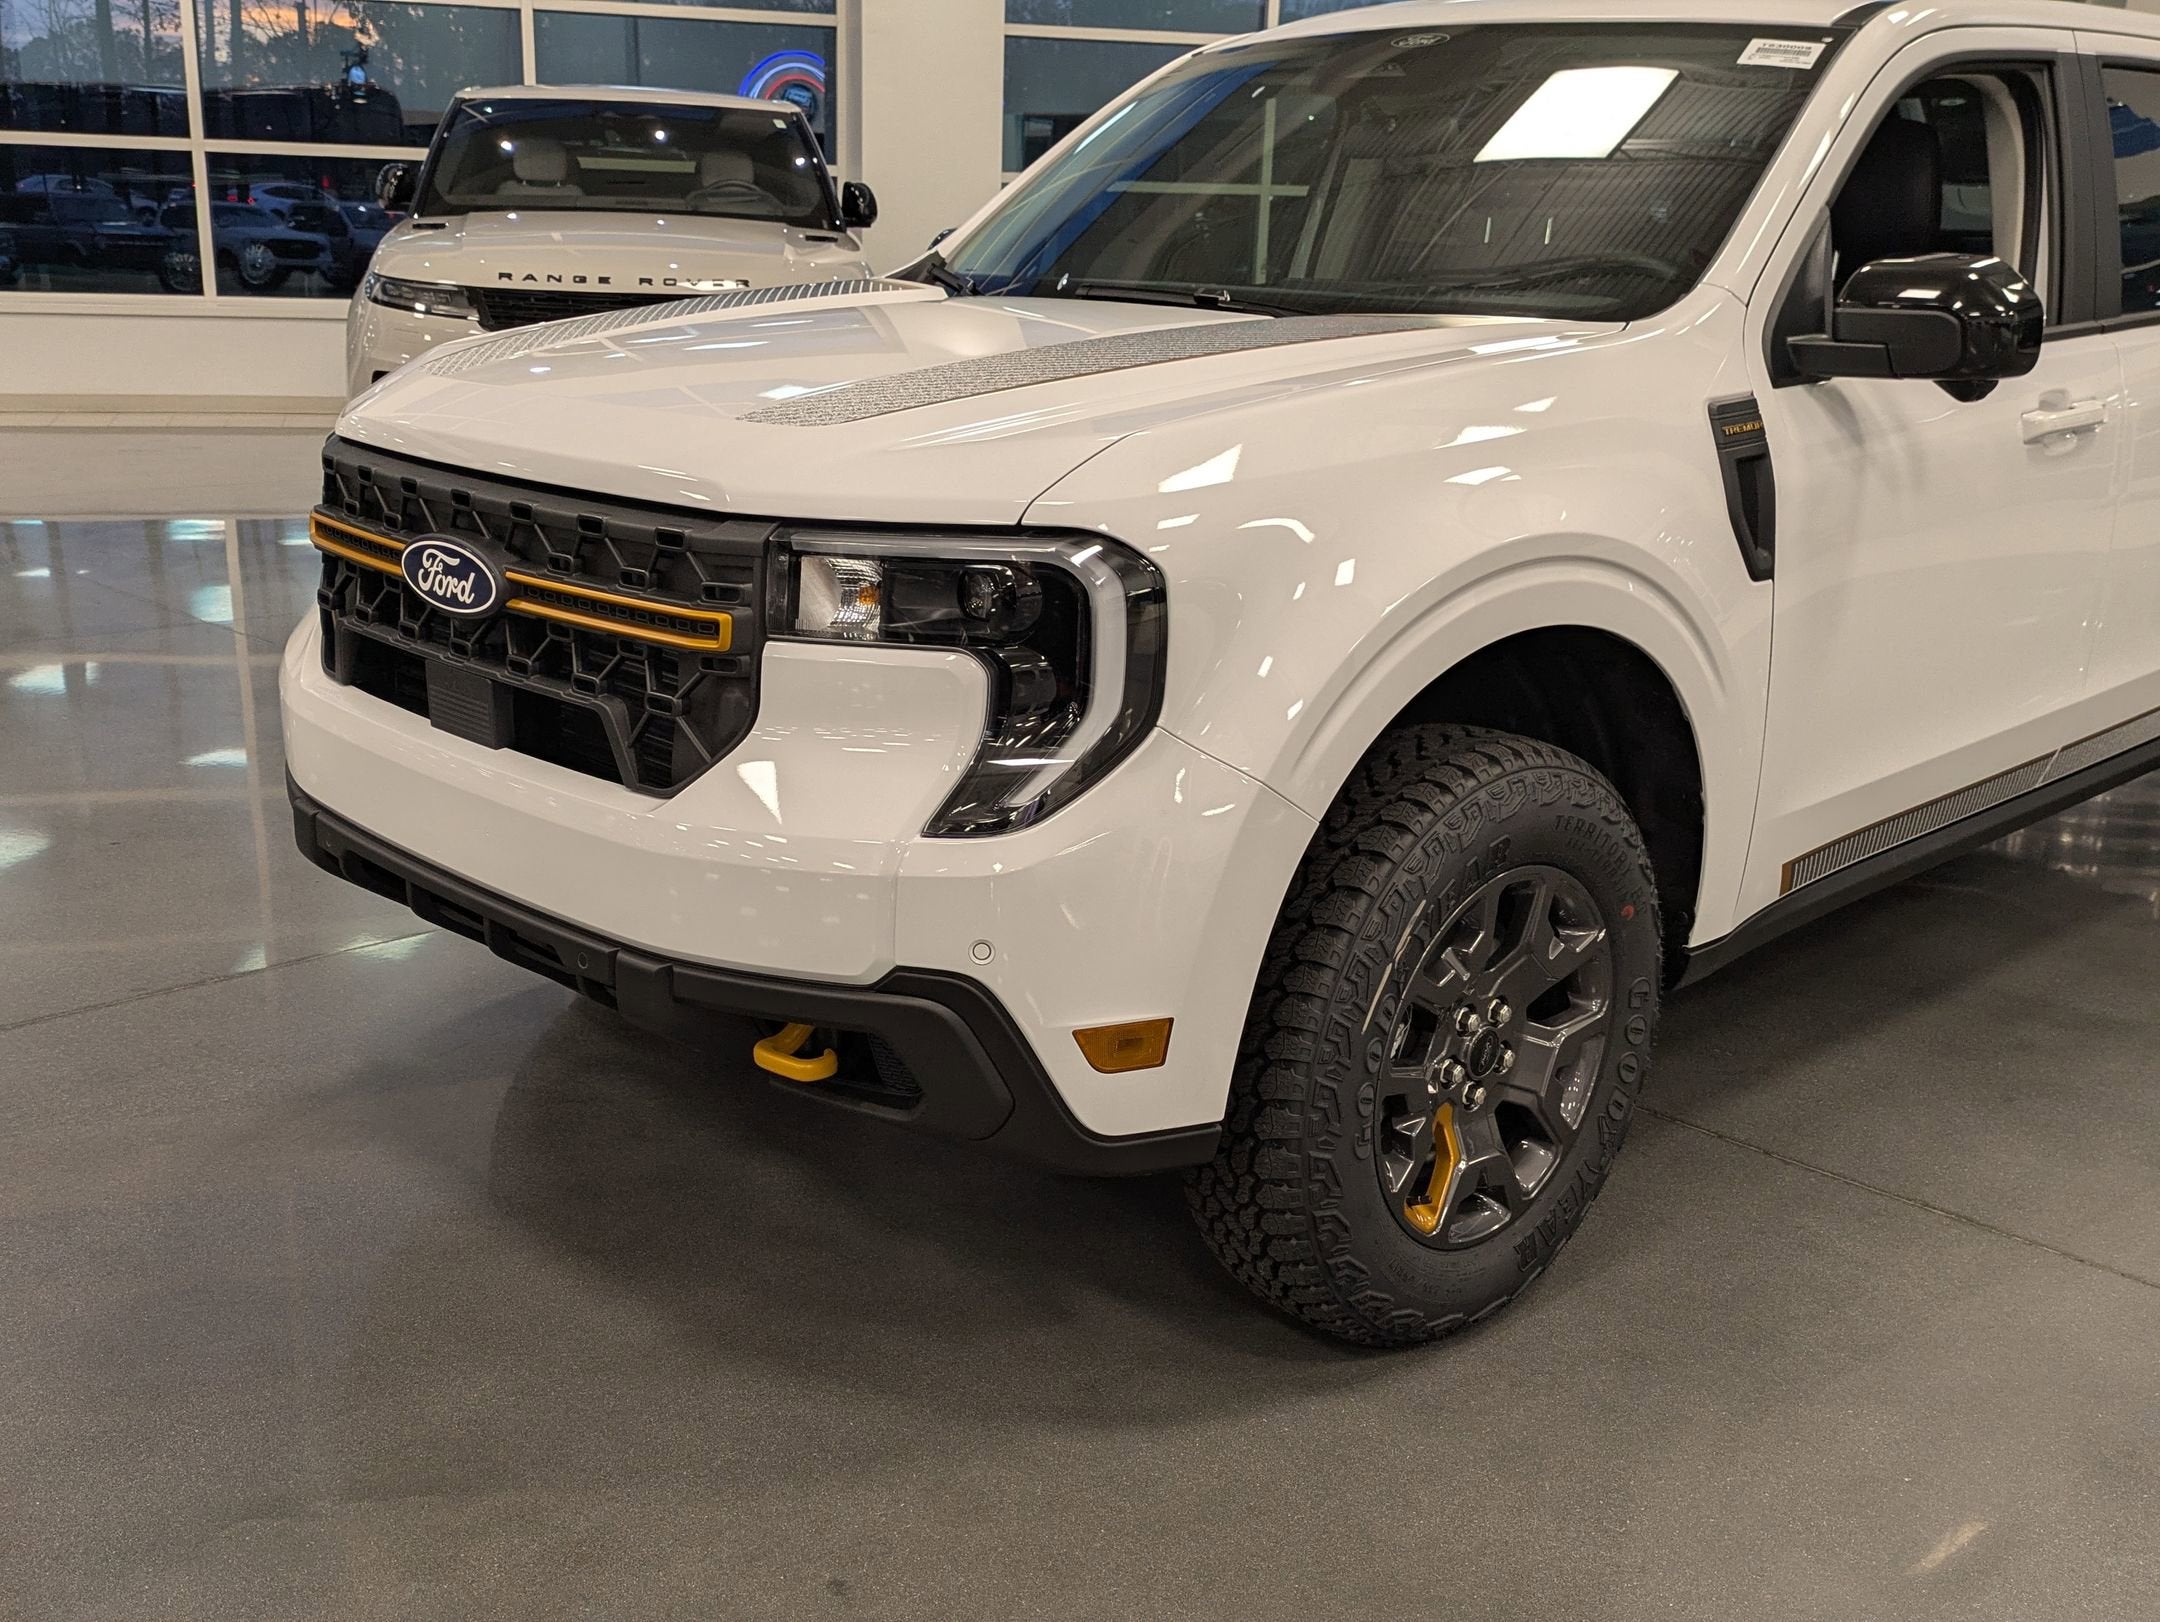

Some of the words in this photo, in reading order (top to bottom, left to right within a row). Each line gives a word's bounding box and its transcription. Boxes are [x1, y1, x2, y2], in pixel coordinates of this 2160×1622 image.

[498, 272, 611, 284] RANGE
[639, 277, 750, 288] ROVER
[418, 548, 475, 605] Ford
[1553, 815, 1632, 875] TERRITORY
